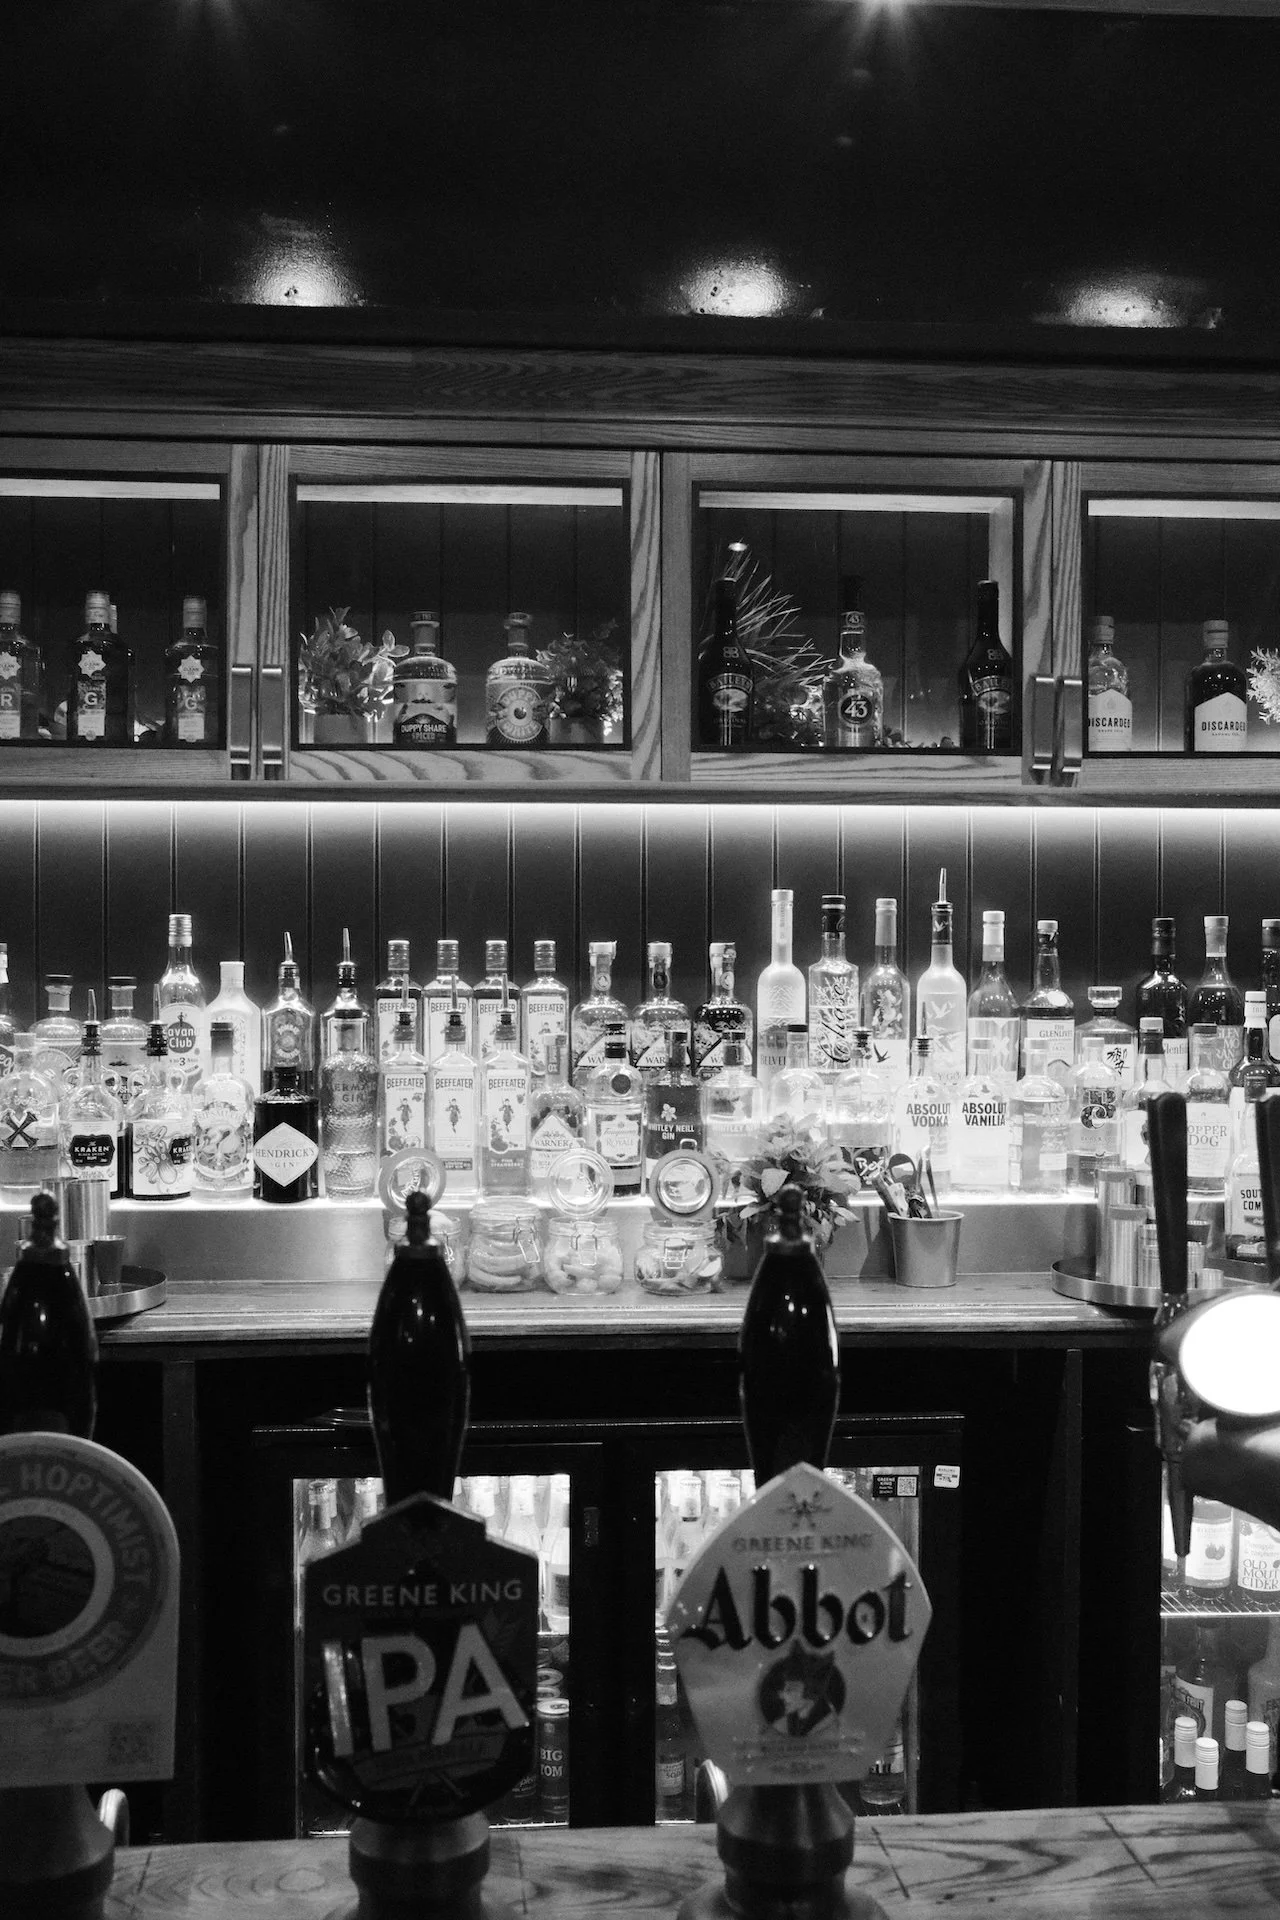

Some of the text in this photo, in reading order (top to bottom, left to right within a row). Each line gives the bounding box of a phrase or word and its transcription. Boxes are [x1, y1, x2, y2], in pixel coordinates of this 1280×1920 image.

[709, 674, 751, 689] BAILEYS
[84, 692, 98, 706] G
[185, 697, 198, 710] G
[844, 700, 868, 718] 43
[400, 724, 448, 734] DUPPY SHARE
[528, 1004, 565, 1014] BEEFEATER
[170, 1037, 192, 1048] Club
[179, 1057, 186, 1066] 3
[387, 1078, 424, 1089] BEEFEATER
[436, 1079, 473, 1090] BEEFEATER
[489, 1079, 526, 1090] BEEFEATER
[906, 1103, 950, 1115] ABSOLUT
[962, 1102, 1007, 1115] ABSOLUT
[911, 1115, 949, 1127] VODKA
[965, 1114, 1006, 1127] VANILIA
[675, 1124, 694, 1132] NEILL
[1187, 1125, 1227, 1137] OPPER
[662, 1132, 676, 1140] GIN
[1189, 1134, 1219, 1147] DOG
[274, 1161, 295, 1169] GIN
[731, 1536, 816, 1552] GREENE
[1243, 1559, 1267, 1570] OLD
[1242, 1577, 1280, 1590] CIDER
[322, 1578, 522, 1607] GREENE KING
[678, 1564, 913, 1651] Abbot
[322, 1622, 531, 1757] IPA
[540, 1749, 563, 1761] BIG
